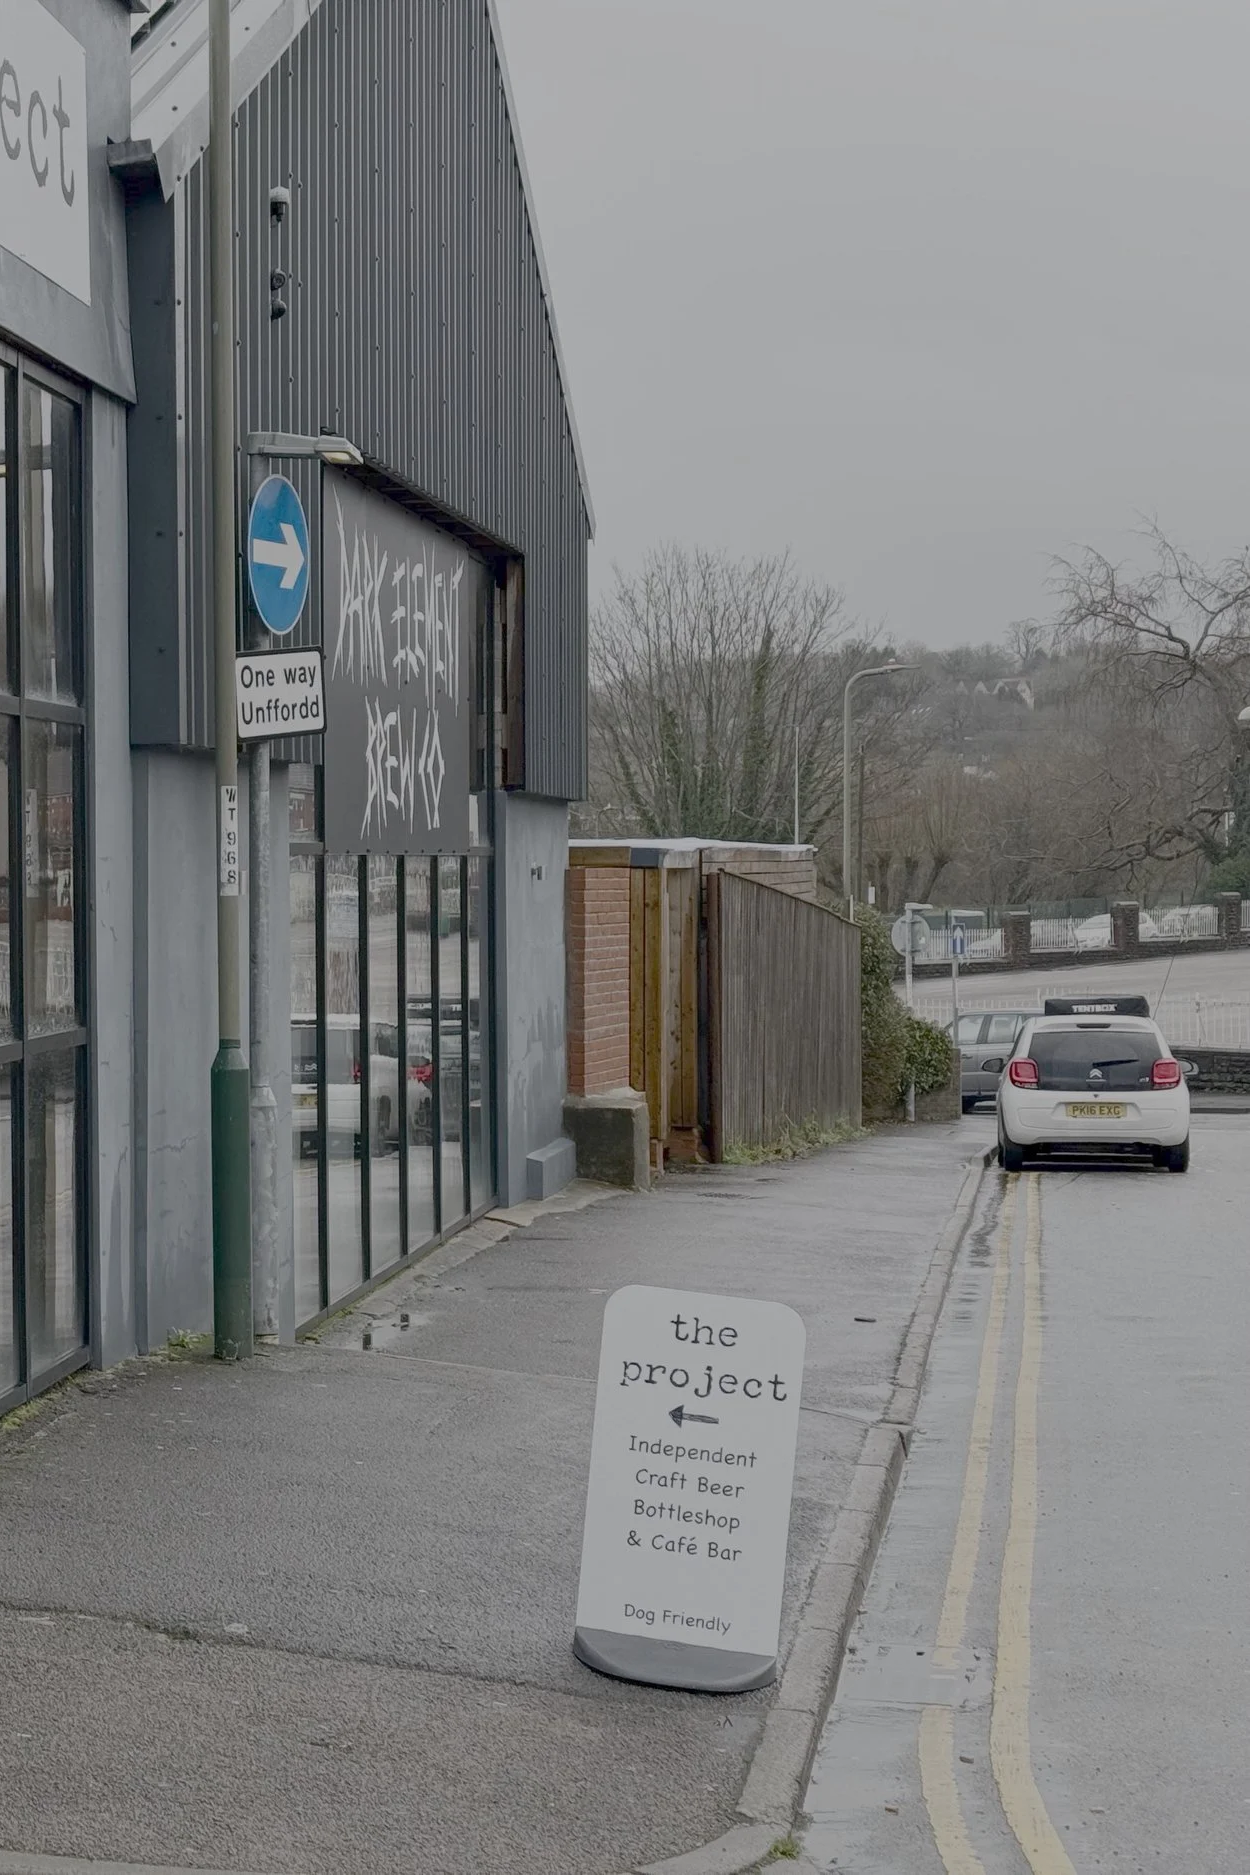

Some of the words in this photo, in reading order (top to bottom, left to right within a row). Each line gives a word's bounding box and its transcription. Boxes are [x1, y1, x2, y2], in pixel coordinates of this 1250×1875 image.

[241, 665, 275, 688] One
[283, 665, 316, 687] way
[242, 695, 319, 725] Unffordd
[1072, 1004, 1116, 1013] TENTBOX
[1072, 1105, 1096, 1116] PK16
[1099, 1105, 1121, 1116] EXG
[670, 1314, 738, 1347] the
[620, 1361, 787, 1401] project
[629, 1435, 757, 1468] Independent
[636, 1469, 687, 1490] Craft
[698, 1476, 745, 1498] Beer
[634, 1499, 740, 1534] Bottleshop
[627, 1530, 642, 1547] &
[652, 1534, 698, 1555] Café
[708, 1542, 742, 1561] Bar
[624, 1604, 655, 1625] Dog
[663, 1610, 731, 1636] Friendly
